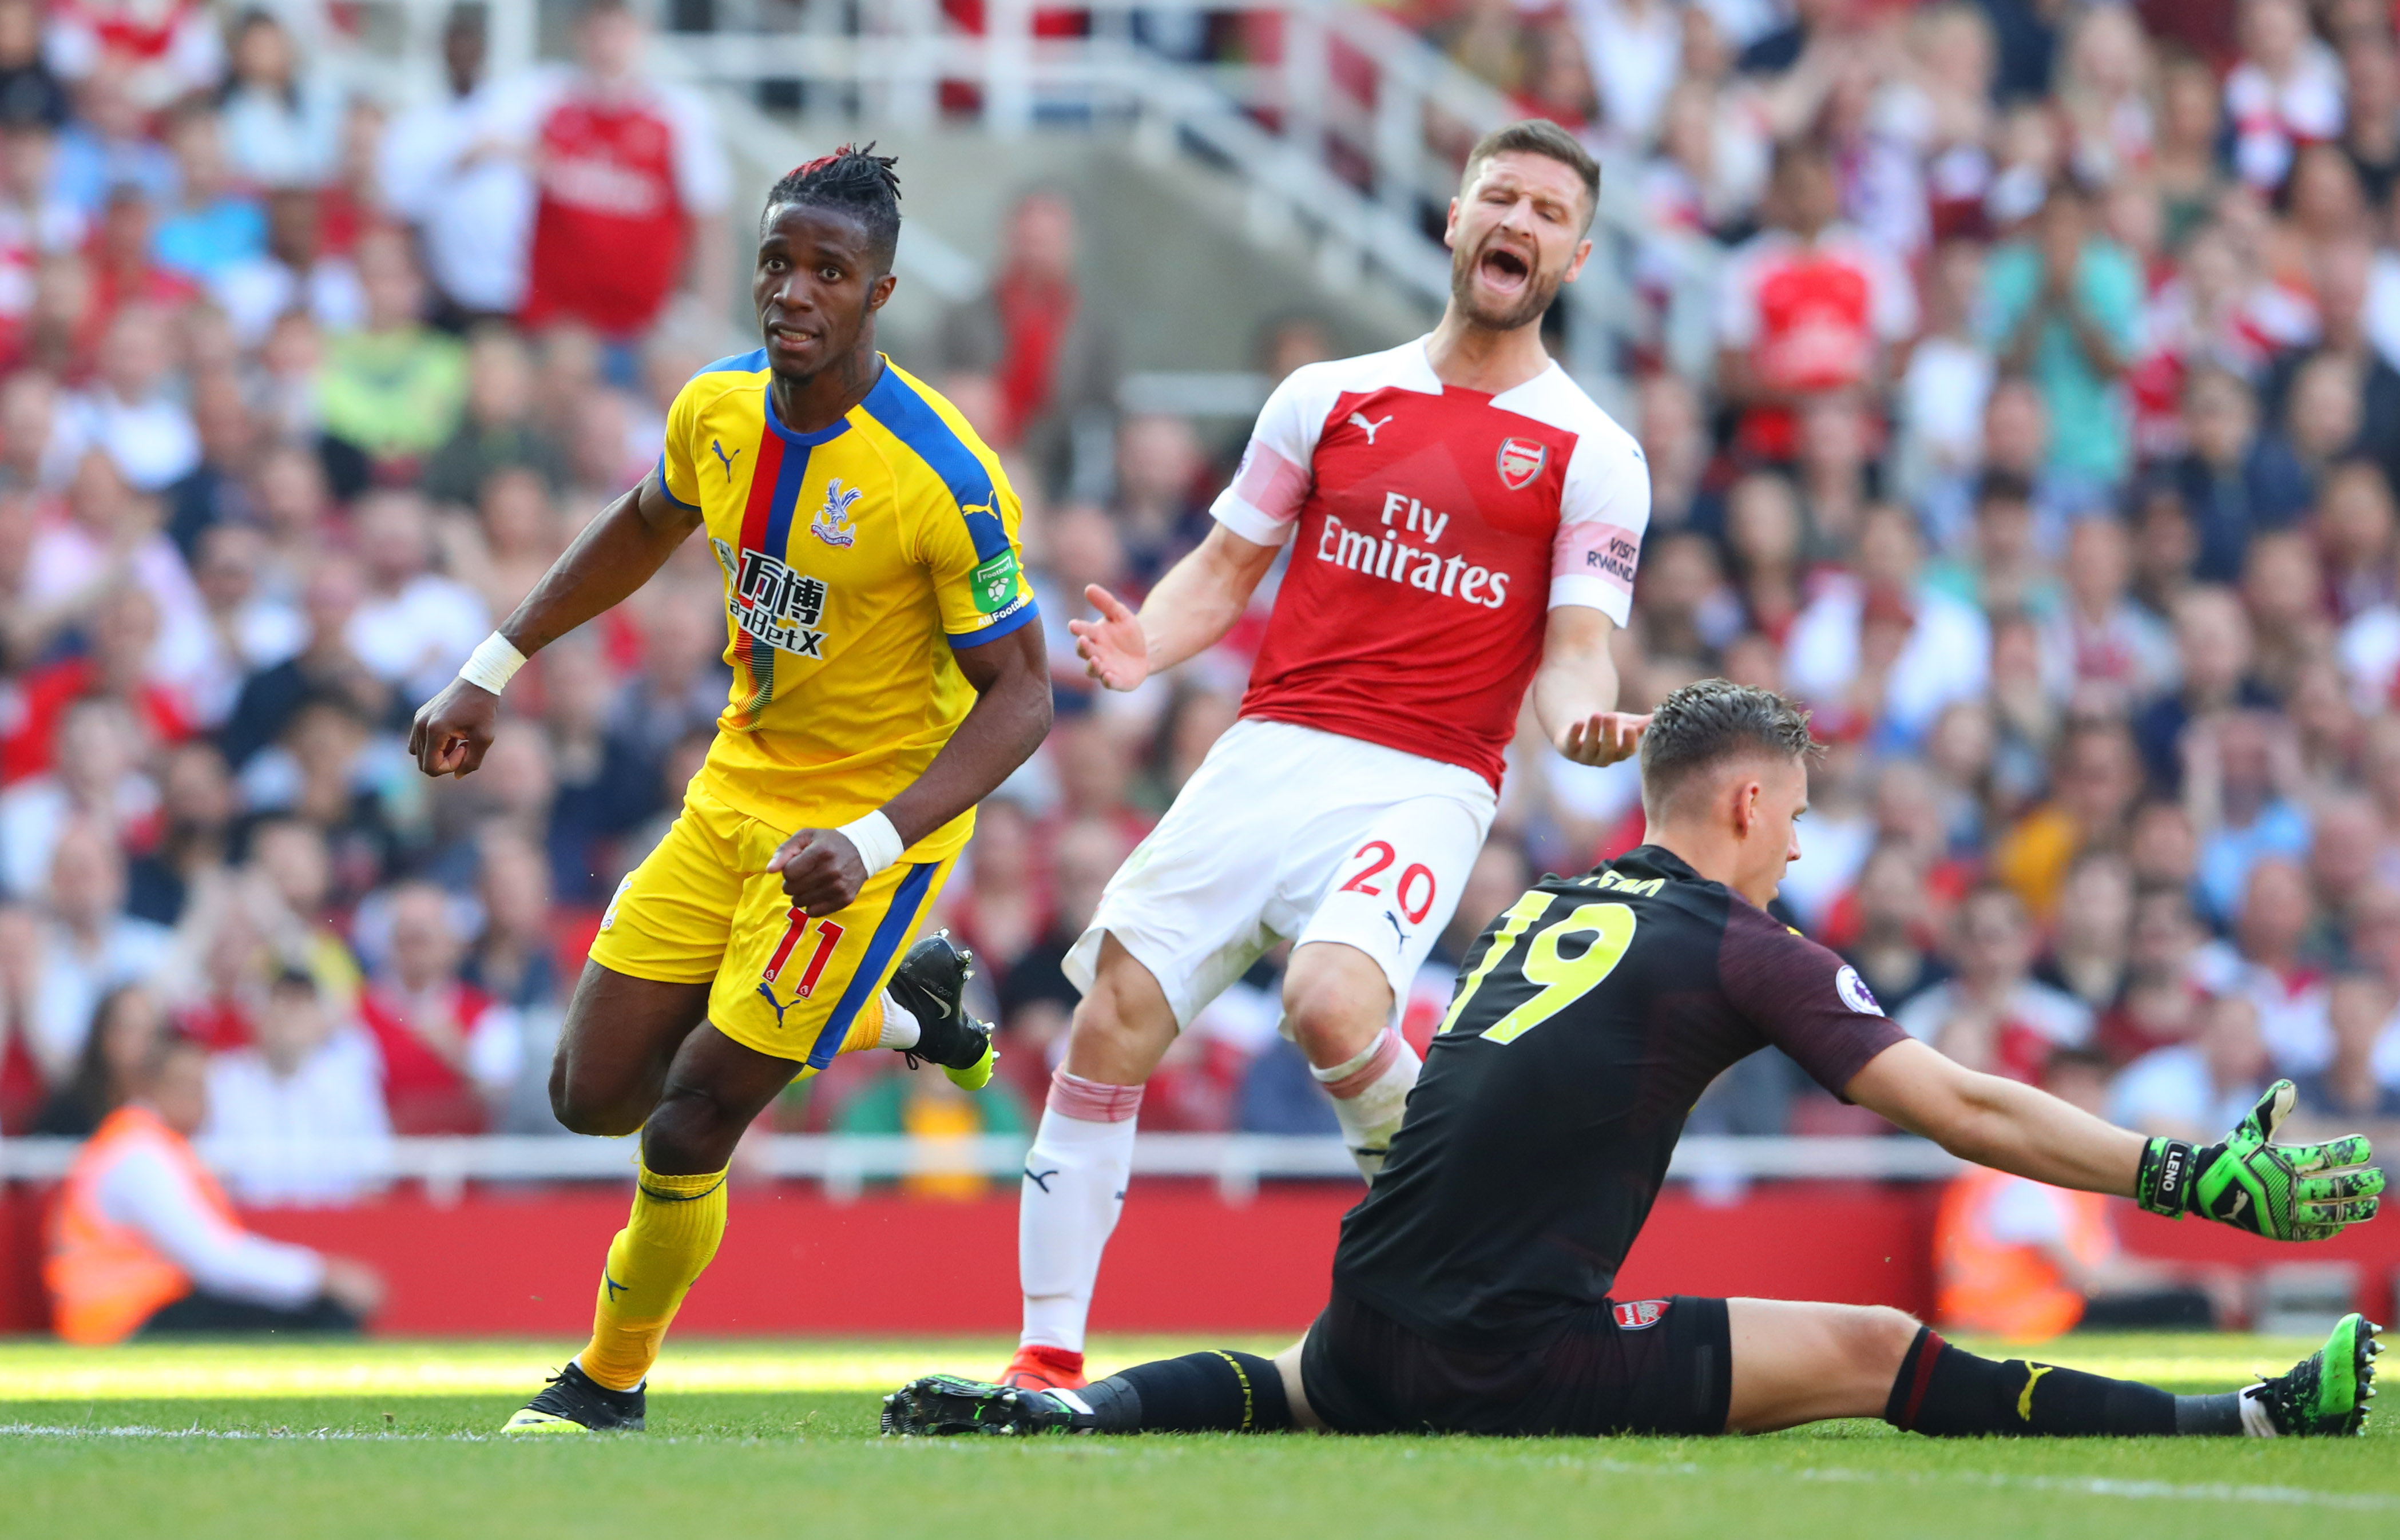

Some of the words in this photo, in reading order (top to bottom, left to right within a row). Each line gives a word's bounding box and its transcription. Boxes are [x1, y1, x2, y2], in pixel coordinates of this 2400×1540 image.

[1381, 491, 1449, 543] Fly
[982, 562, 1011, 580] Football
[1317, 514, 1510, 609] Emirates
[1587, 550, 1634, 582] RWAND
[1610, 537, 1636, 563] VISIT
[741, 551, 824, 625] 万博
[729, 599, 822, 656] anBetX
[1338, 840, 1435, 925] 20
[761, 906, 846, 999] 11
[1438, 890, 1637, 1045] 19
[2163, 1151, 2183, 1192] LENO
